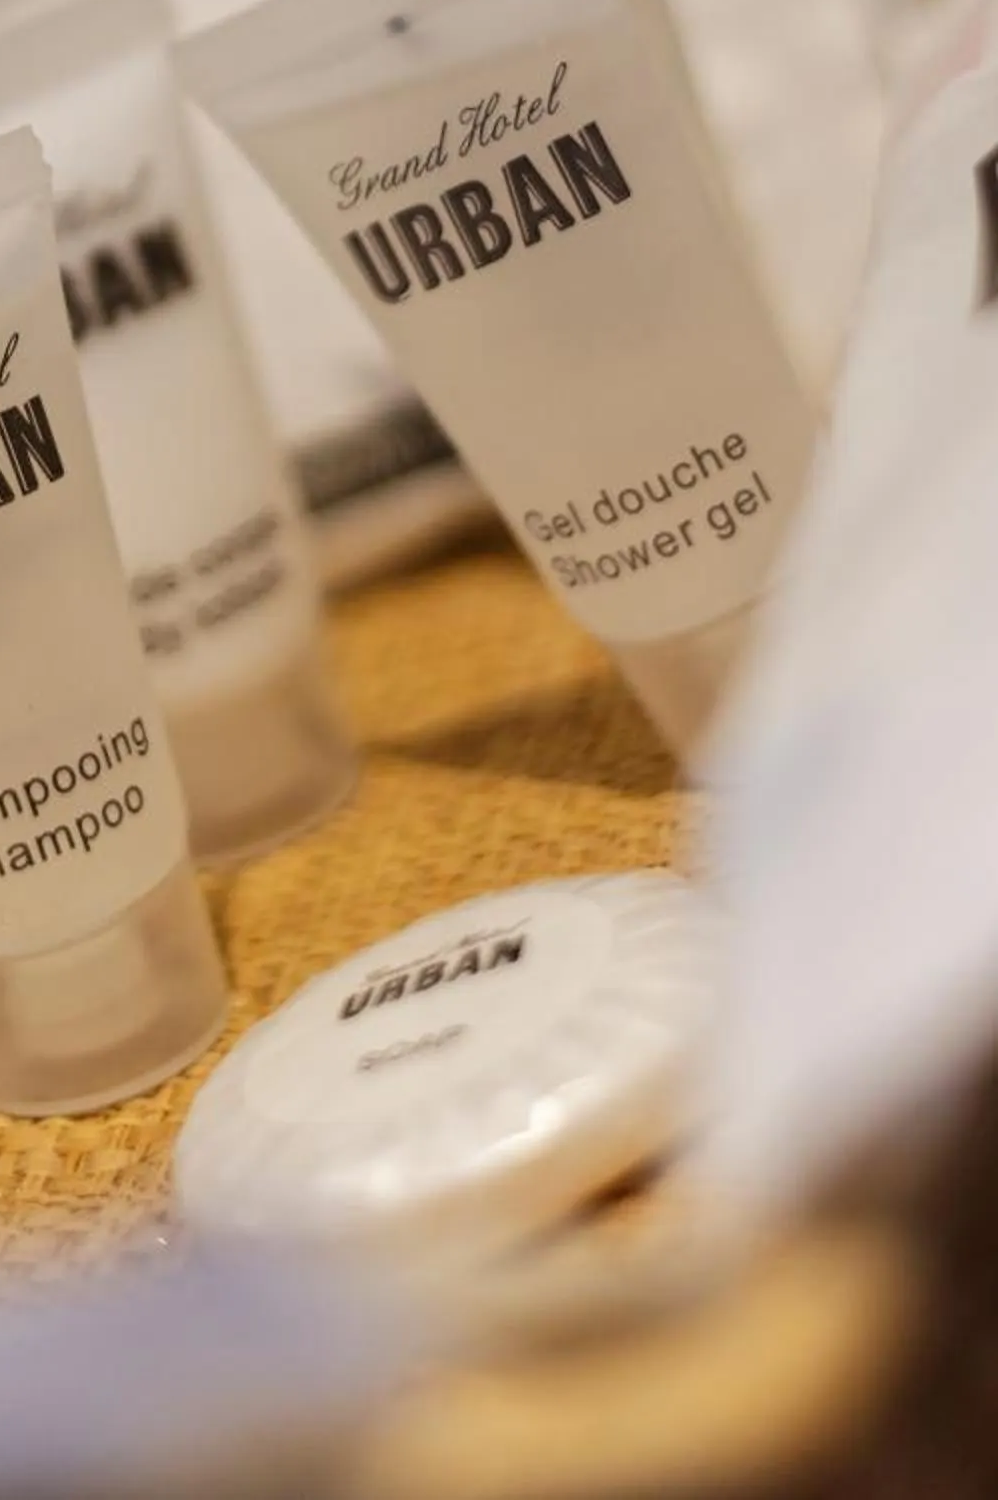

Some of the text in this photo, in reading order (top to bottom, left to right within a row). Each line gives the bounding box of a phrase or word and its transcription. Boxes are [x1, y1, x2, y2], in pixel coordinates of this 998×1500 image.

[329, 61, 568, 210] Grand Hotel
[343, 120, 632, 305] URBAN
[524, 431, 748, 544] Gel douche
[550, 470, 772, 590] Shower gel
[339, 934, 527, 1020] URBAN
